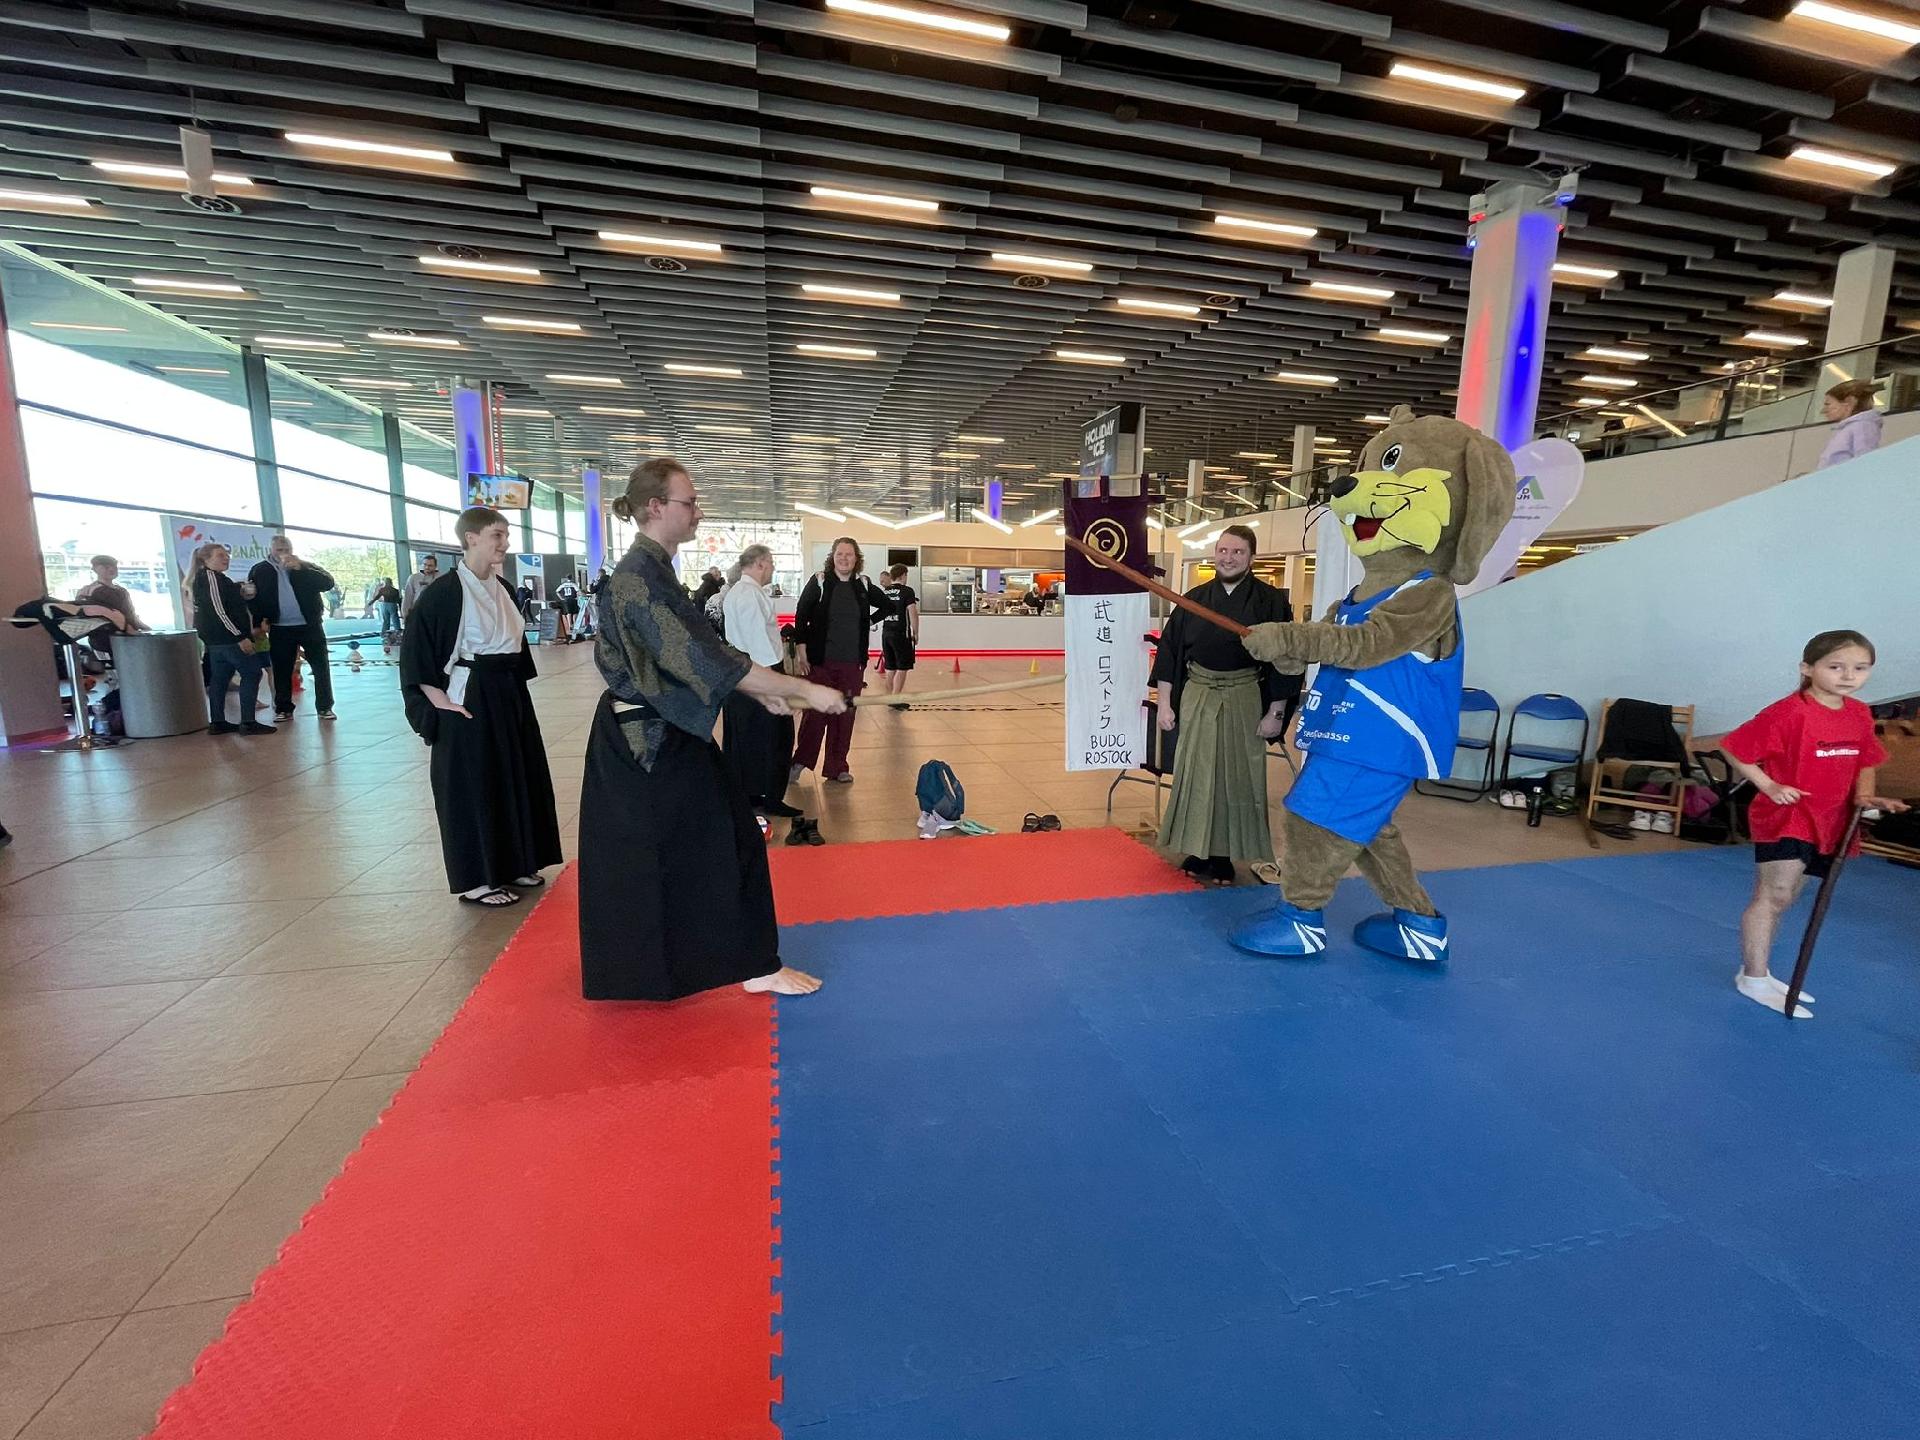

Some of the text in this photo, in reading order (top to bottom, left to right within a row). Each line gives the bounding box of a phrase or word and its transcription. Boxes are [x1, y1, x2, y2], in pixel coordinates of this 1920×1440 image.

[1085, 420, 1115, 446] HOLIDAY
[1093, 439, 1105, 457] ICE
[1522, 487, 1530, 495] D
[532, 556, 540, 566] P
[564, 587, 572, 597] 10
[1094, 599, 1115, 729] 武道 ロストック
[1090, 733, 1126, 750] BUDO
[1085, 750, 1132, 765] ROSTOCK
